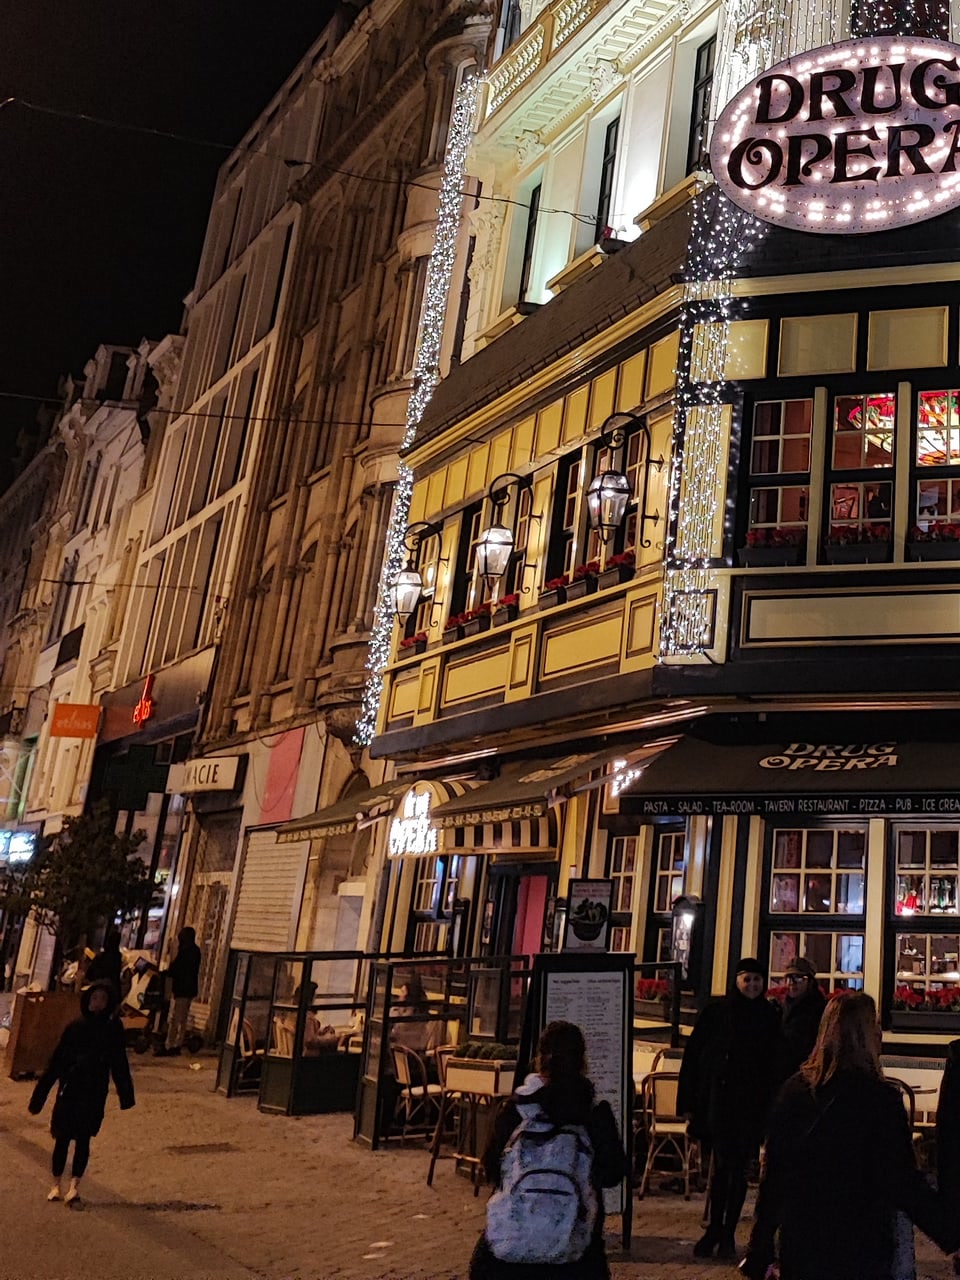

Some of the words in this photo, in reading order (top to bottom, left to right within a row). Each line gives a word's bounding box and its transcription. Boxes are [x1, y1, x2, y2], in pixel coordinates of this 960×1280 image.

[783, 742, 897, 757] DRUG
[759, 755, 898, 771] OPERA
[643, 801, 668, 813] PASTA
[678, 801, 703, 813] SALAD
[713, 800, 755, 812] TEA-ROOM
[764, 800, 795, 812] TAVERN
[798, 799, 850, 812] RESTAURANT
[860, 799, 886, 811] PIZZA
[895, 799, 912, 811] PUB
[922, 799, 935, 811] ICE
